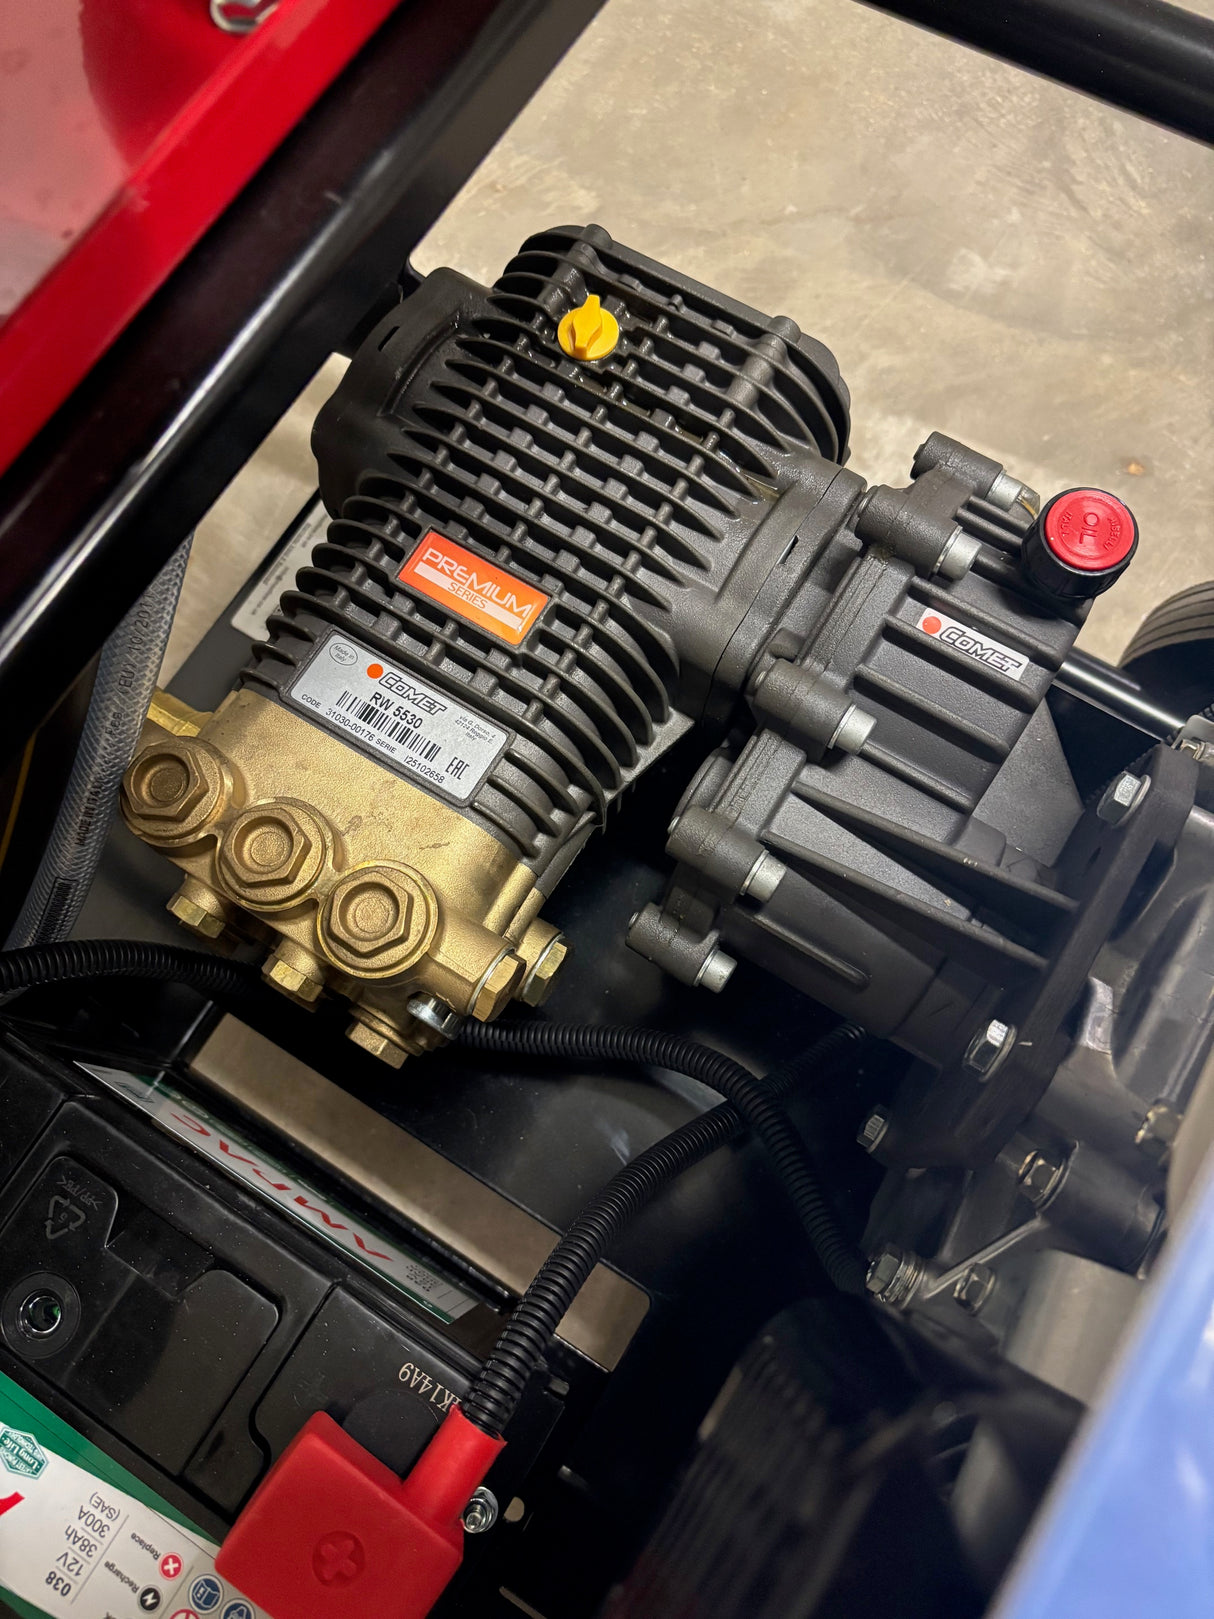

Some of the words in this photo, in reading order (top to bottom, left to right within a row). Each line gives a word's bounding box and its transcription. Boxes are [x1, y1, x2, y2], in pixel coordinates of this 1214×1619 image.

[1078, 512, 1100, 544] OIL
[422, 548, 532, 618] PREMIUM
[448, 582, 488, 609] SERIES
[334, 645, 349, 657] Made
[939, 626, 1023, 673] COMET
[117, 663, 138, 694] (EU)
[379, 671, 447, 715] COMET
[301, 693, 322, 709] CODE
[325, 708, 375, 741] 31030-00176
[375, 738, 397, 755] SERIE
[369, 691, 395, 711] RW
[392, 705, 423, 729] 5530
[398, 1362, 462, 1412] K14A9
[3, 1437, 20, 1454] Life
[19, 1449, 39, 1470] Long
[77, 1505, 111, 1538] 300A
[89, 1491, 121, 1522] (SAE)
[64, 1524, 98, 1558] 38Ah
[130, 1532, 161, 1560] Replace
[55, 1551, 84, 1577] 12V
[104, 1560, 140, 1594] Recharge
[45, 1571, 72, 1597] 038
